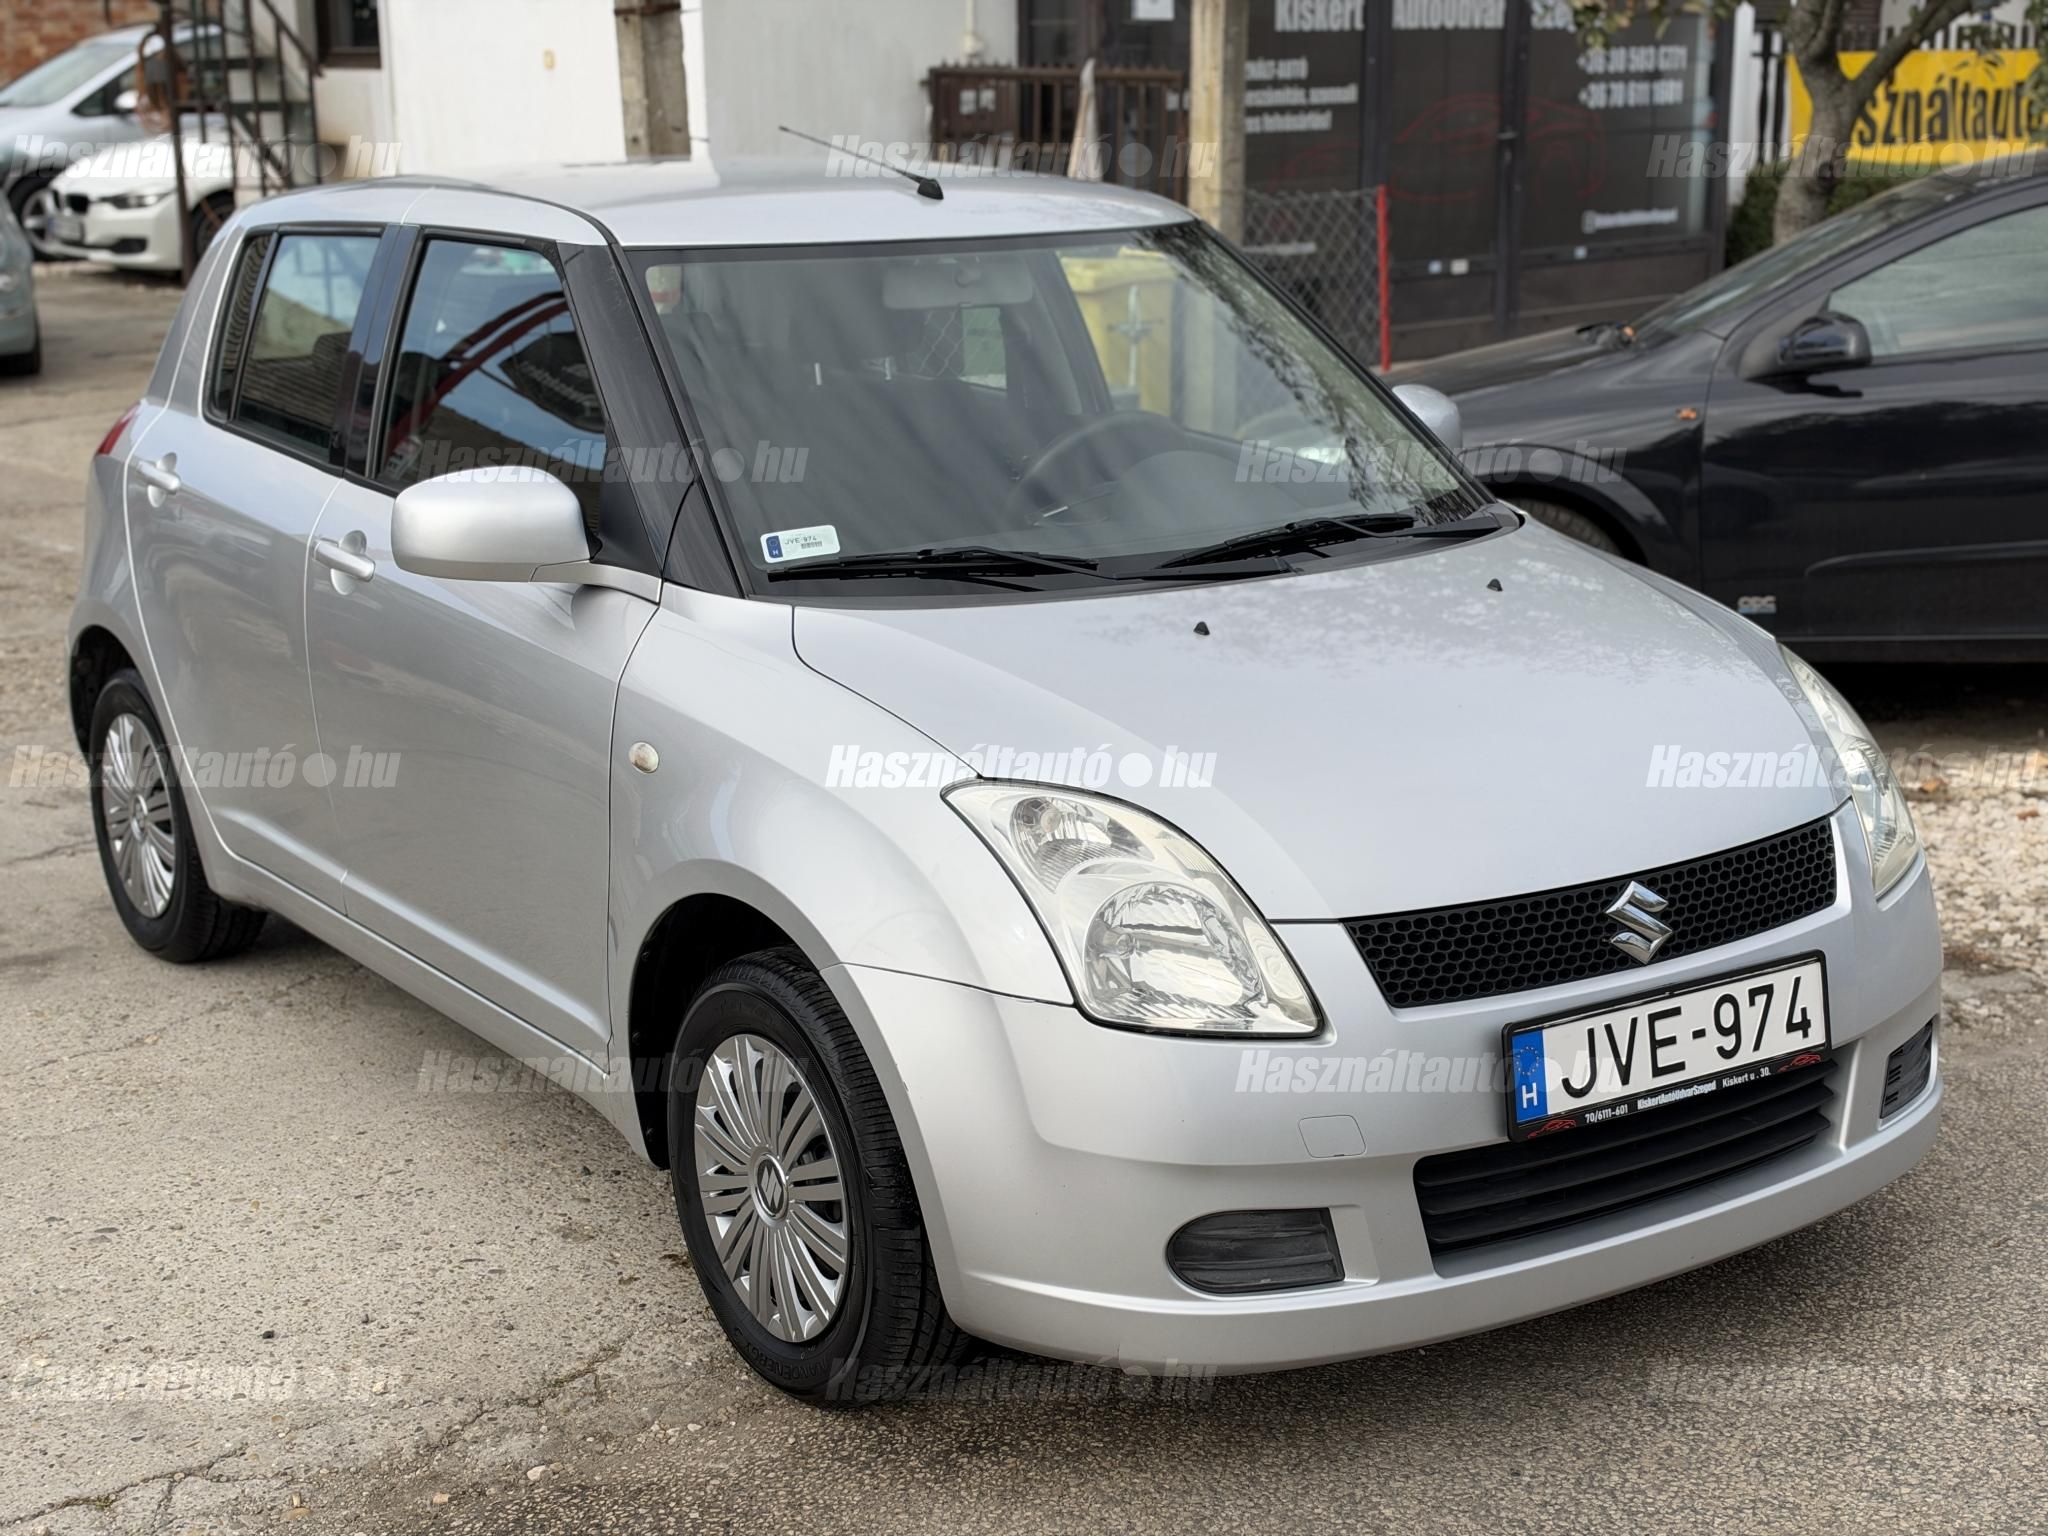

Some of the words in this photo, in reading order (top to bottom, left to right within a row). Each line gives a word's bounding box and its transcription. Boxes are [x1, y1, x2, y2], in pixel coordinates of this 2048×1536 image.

[1561, 975, 1812, 1099] JVE-974
[1521, 1082, 1538, 1109] H
[1584, 1104, 1629, 1124] 70/6111-601
[1722, 1074, 1748, 1088] Kiskert
